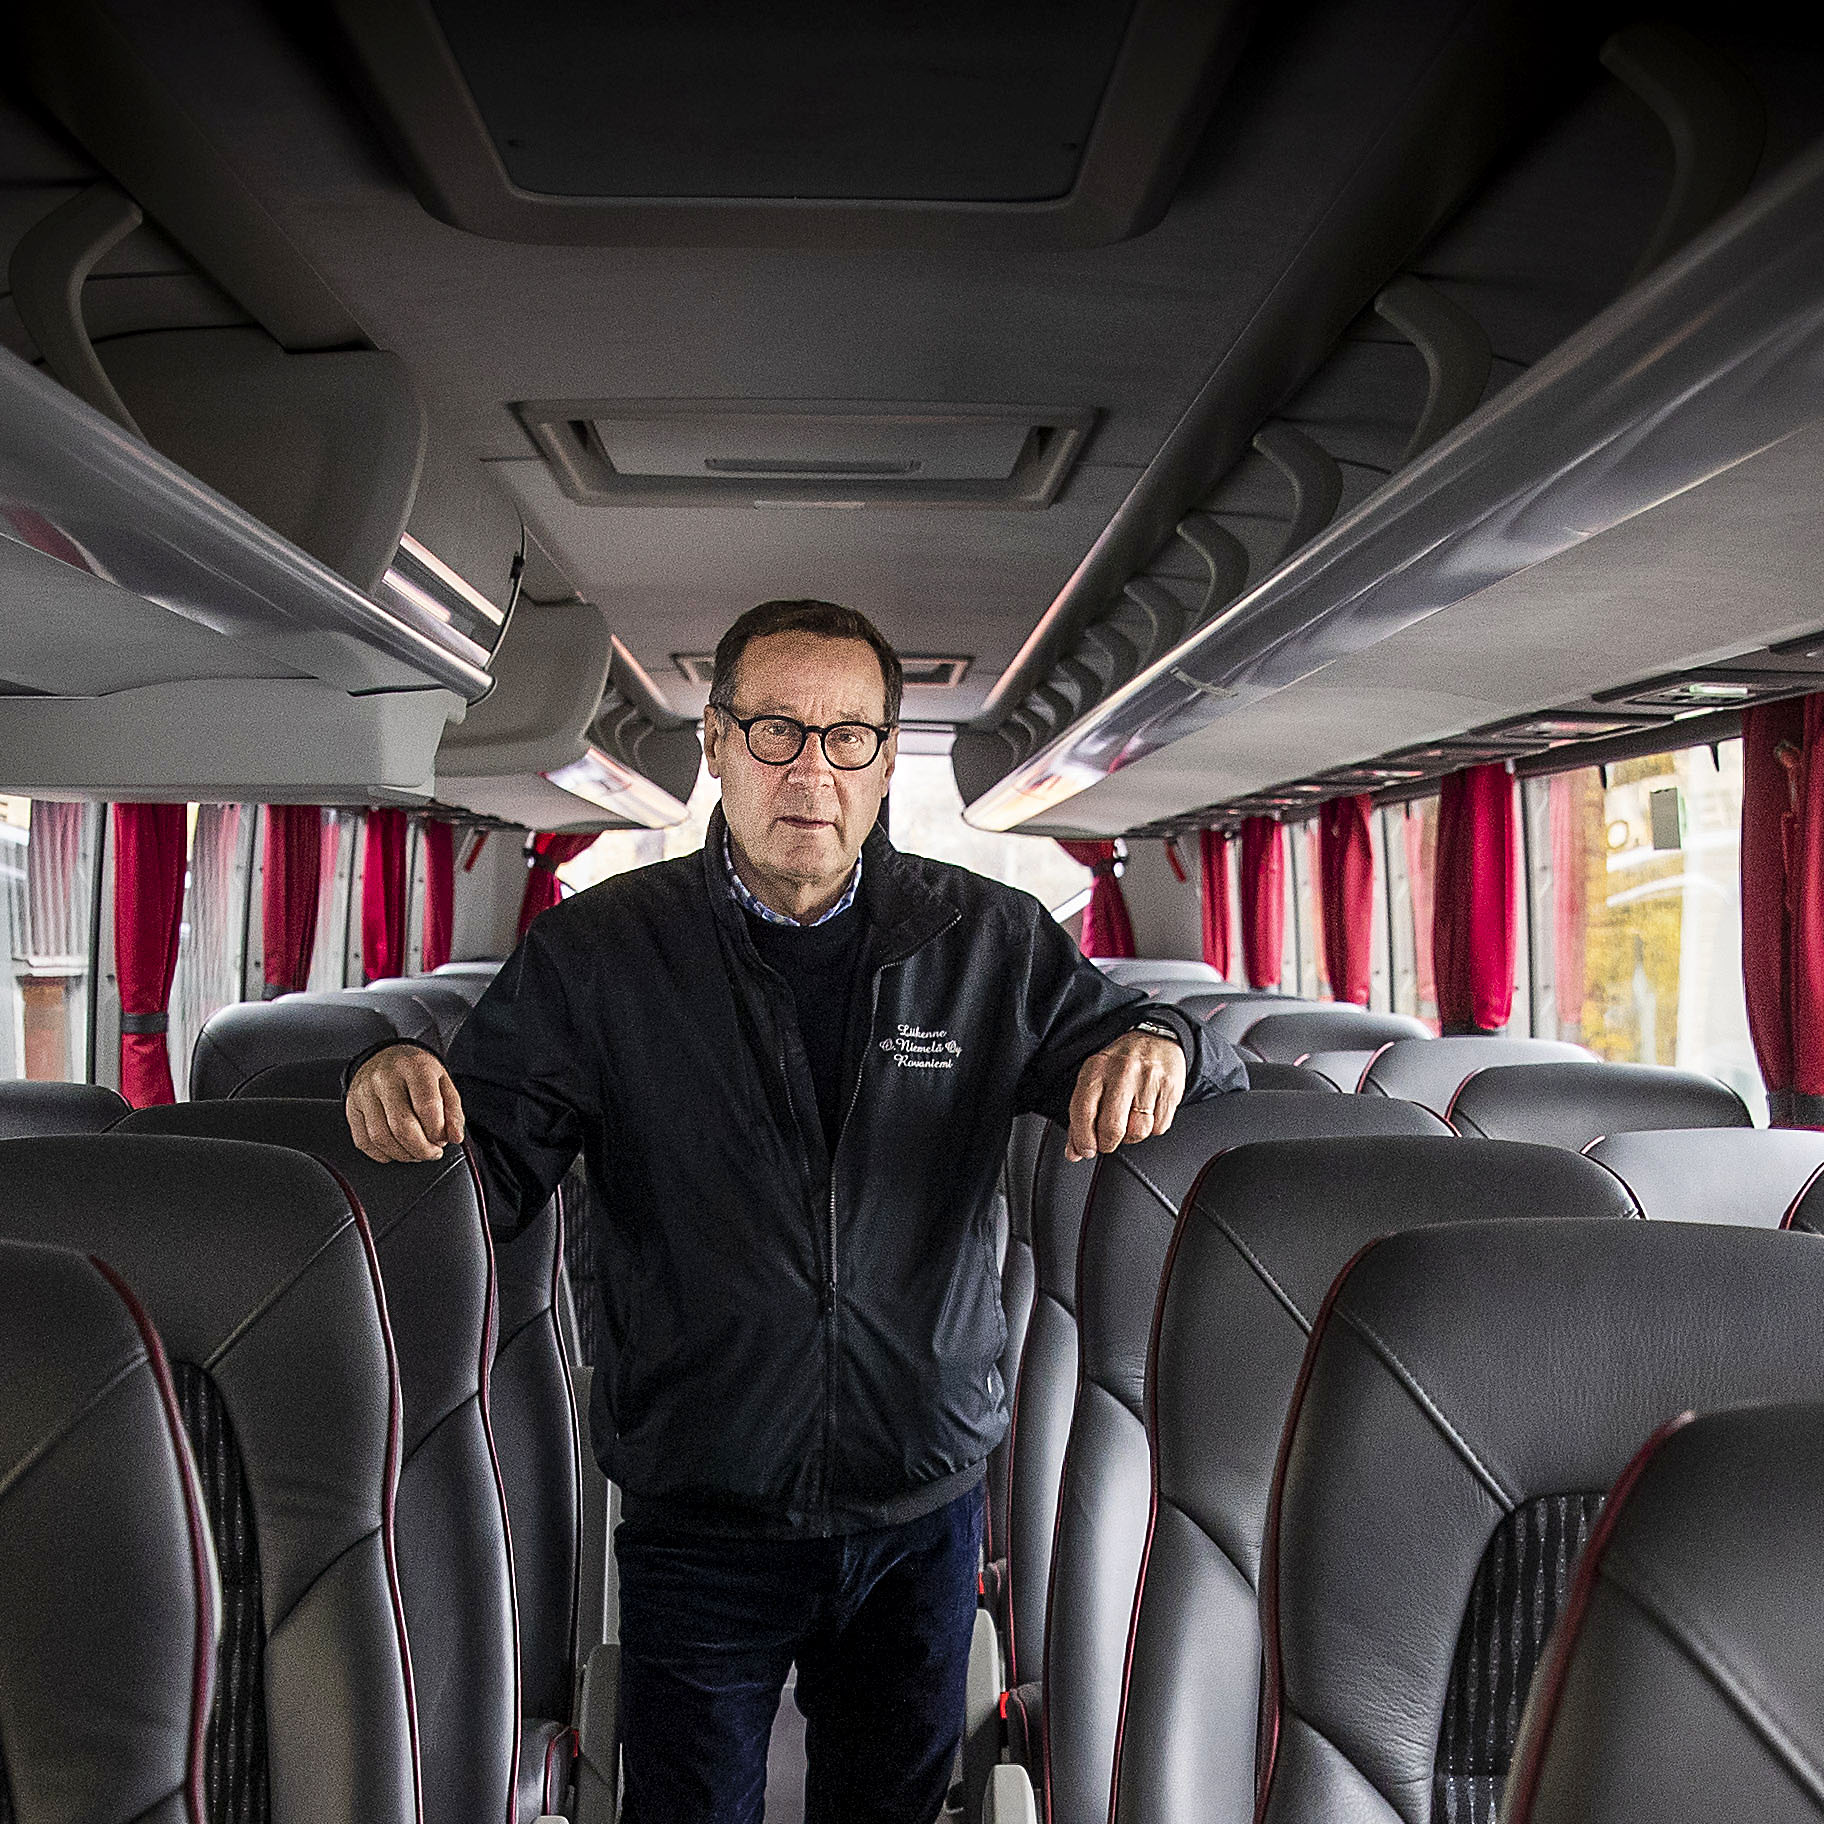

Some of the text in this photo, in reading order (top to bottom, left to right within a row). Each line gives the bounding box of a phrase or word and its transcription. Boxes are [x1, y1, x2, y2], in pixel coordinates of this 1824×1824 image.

[897, 1024, 947, 1038] Liikenne
[945, 1040, 962, 1058] Oy
[894, 1053, 953, 1068] Rovaniemi
